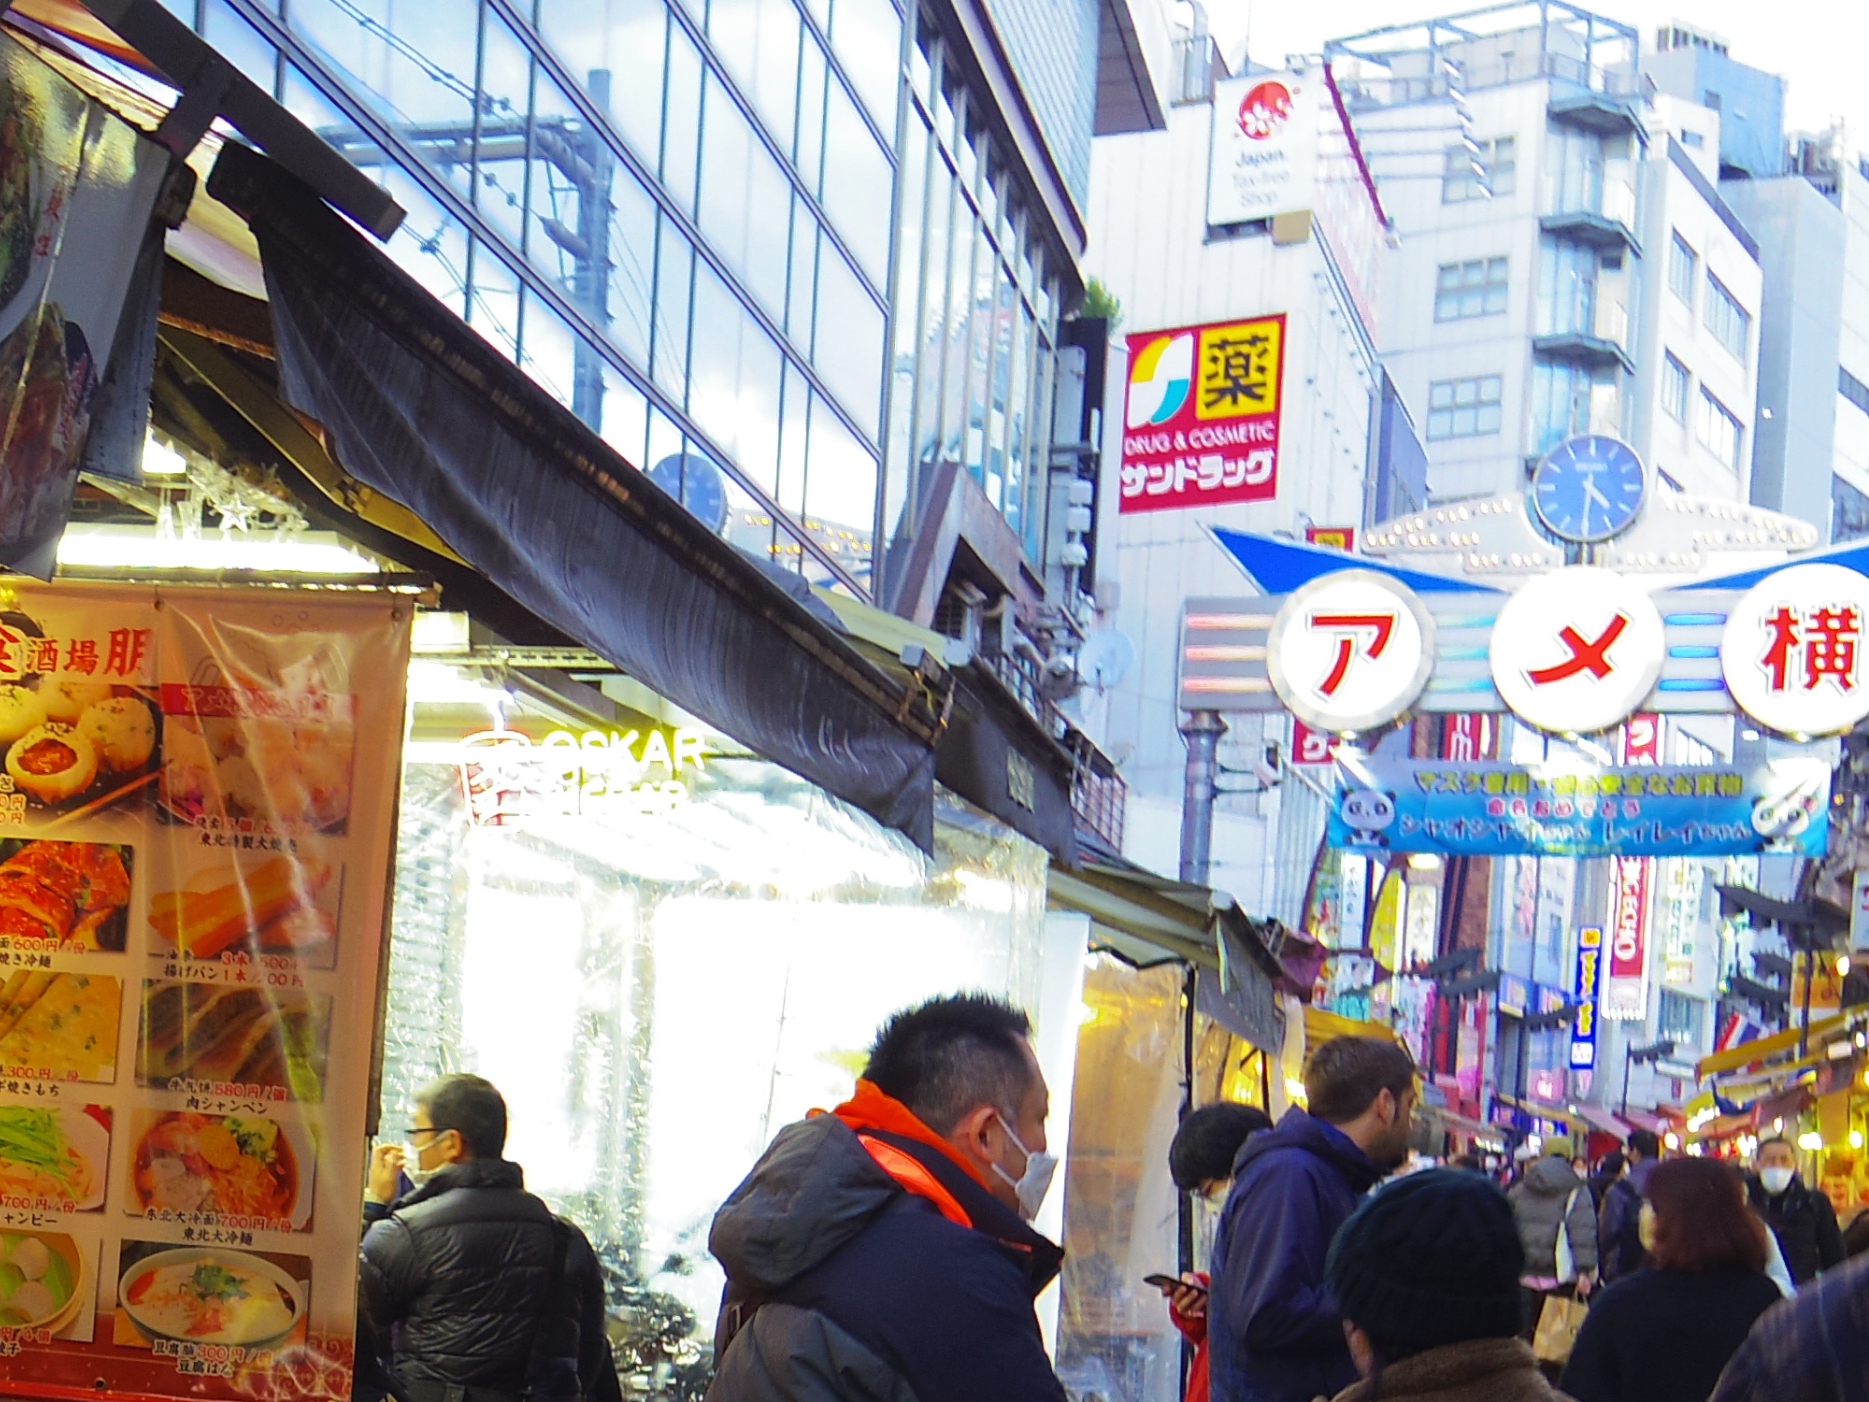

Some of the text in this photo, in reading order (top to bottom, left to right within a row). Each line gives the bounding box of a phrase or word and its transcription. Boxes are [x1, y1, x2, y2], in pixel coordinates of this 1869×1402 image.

[1204, 333, 1270, 409] 薬
[1124, 419, 1276, 457] DRUG & COSMETIC
[1120, 447, 1276, 498] サンドラッグ
